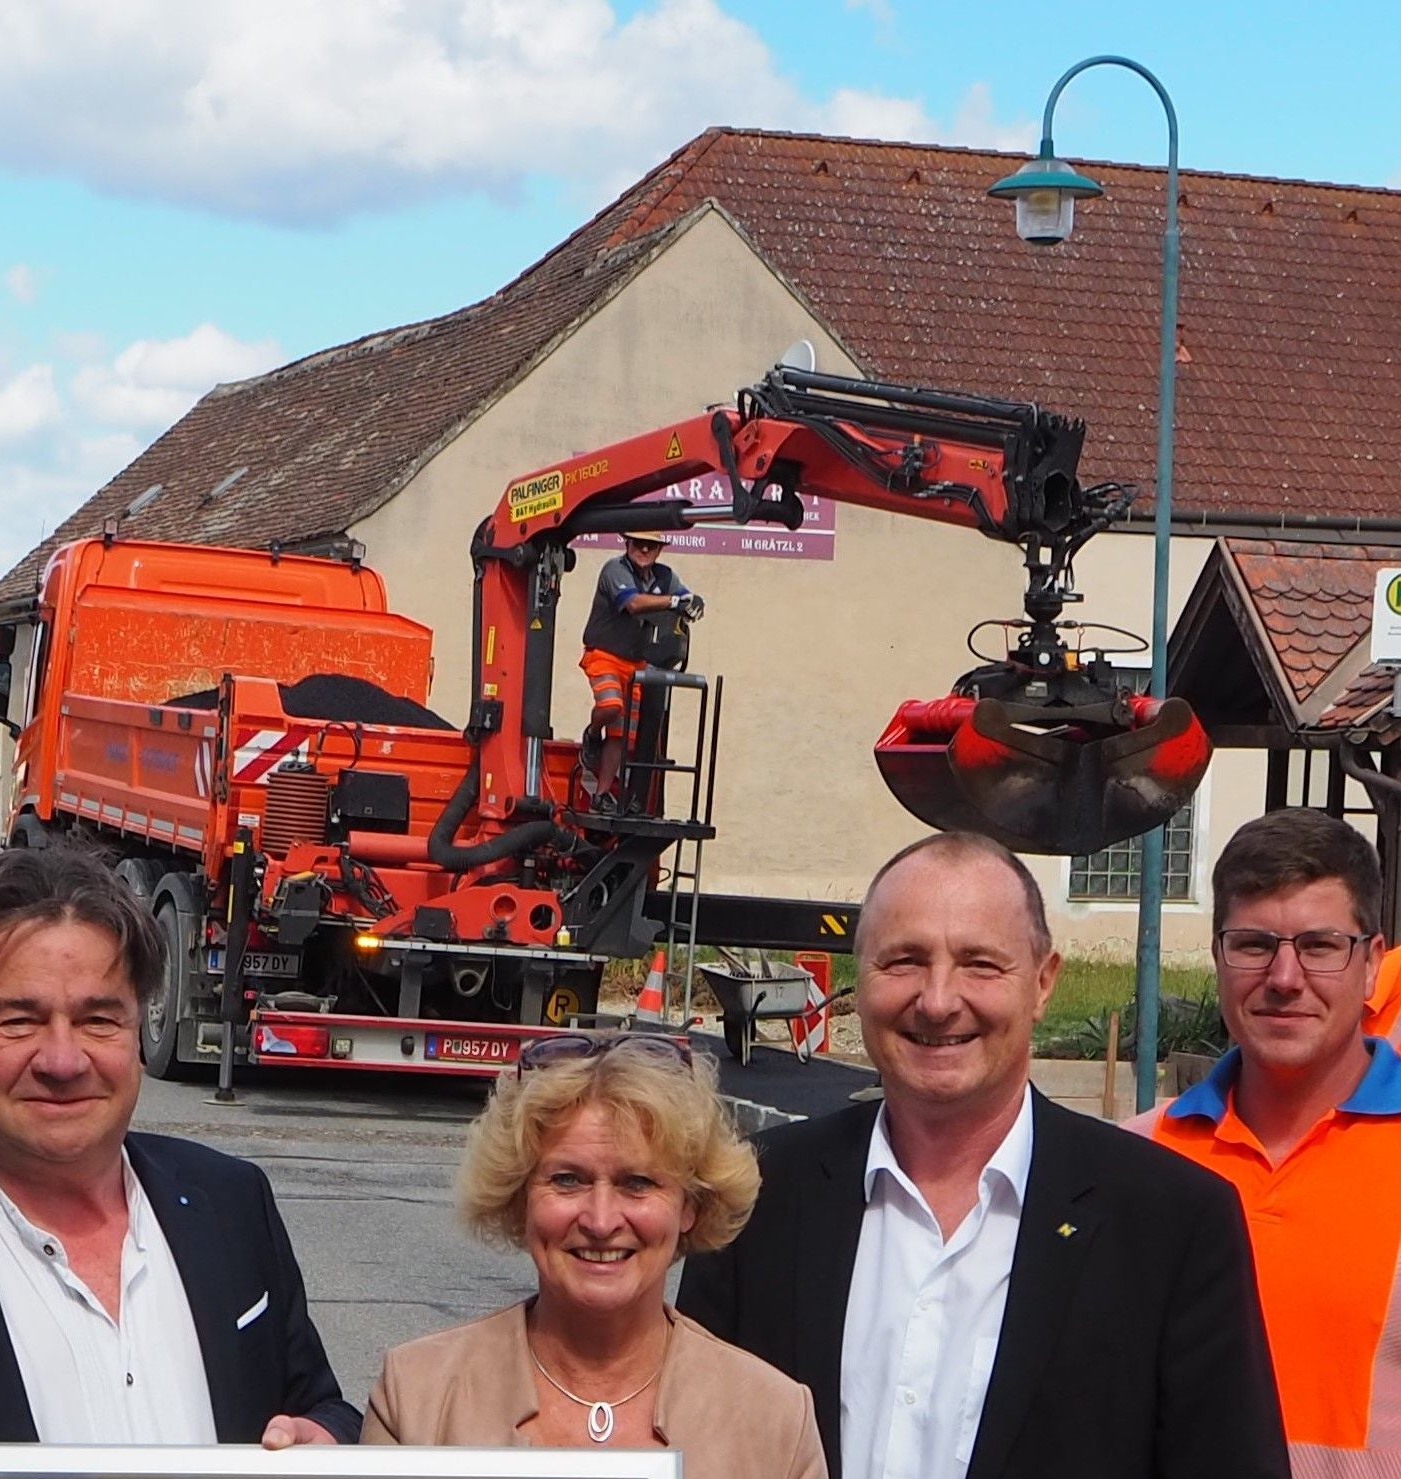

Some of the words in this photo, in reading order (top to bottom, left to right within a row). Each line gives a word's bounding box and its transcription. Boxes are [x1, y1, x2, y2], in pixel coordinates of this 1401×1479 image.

[511, 474, 560, 502] PALFINGER
[797, 542, 804, 552] 2
[271, 956, 290, 971] DY
[554, 994, 571, 1017] R
[490, 1042, 510, 1057] DY
